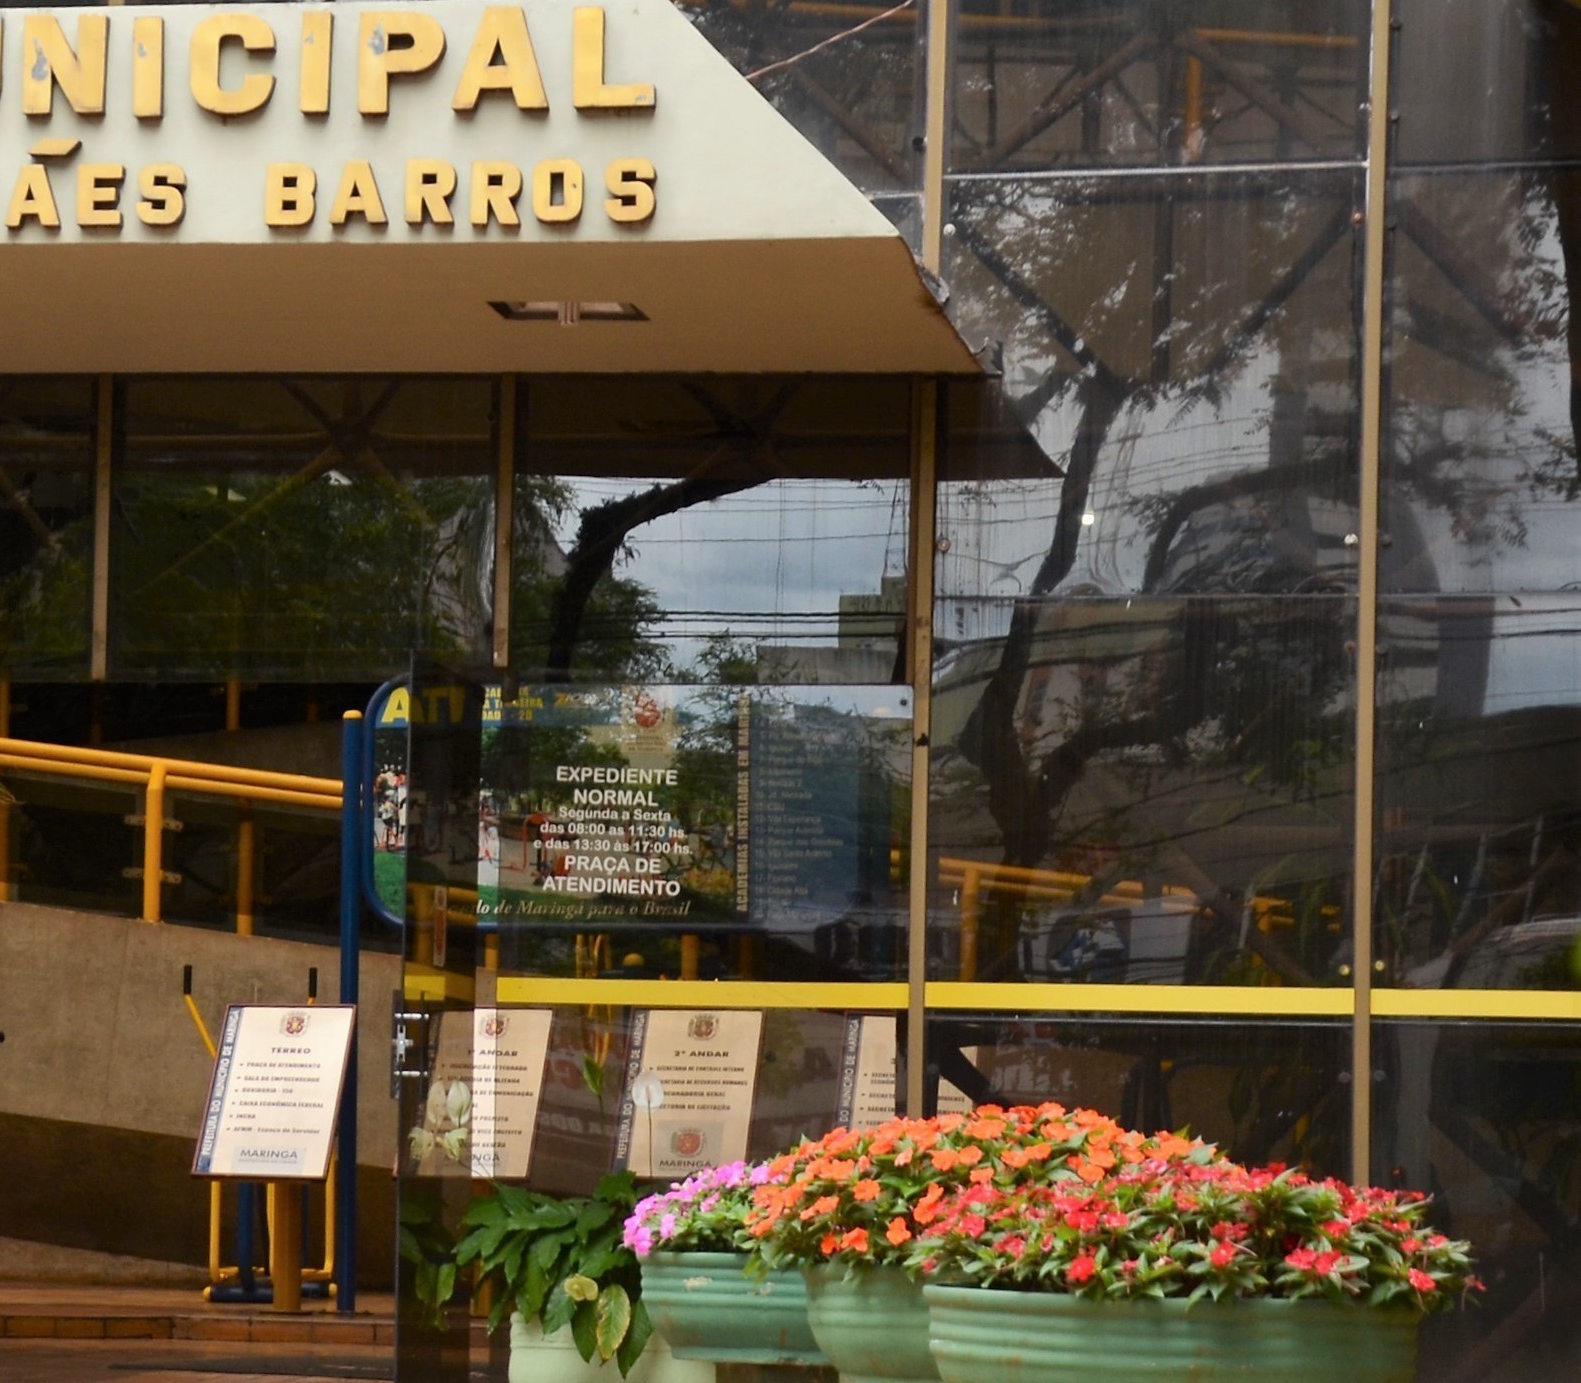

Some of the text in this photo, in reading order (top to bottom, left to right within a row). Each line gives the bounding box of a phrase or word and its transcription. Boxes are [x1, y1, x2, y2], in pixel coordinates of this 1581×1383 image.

[264, 157, 658, 229] BARROS
[556, 765, 679, 786] EXPEDIENTE
[574, 789, 659, 807] NORMAL
[737, 771, 749, 839] INSTALADAS
[559, 806, 671, 821] Segunda a Sexta
[540, 822, 565, 834] das
[568, 823, 606, 835] 08:00
[628, 825, 666, 838] 11:30
[669, 826, 688, 838] hs.
[533, 840, 542, 849] e
[545, 838, 570, 850] das
[574, 839, 610, 851] 13:30
[633, 842, 670, 854] 17:00
[673, 843, 693, 855] hs.
[564, 855, 661, 876] PRAÇA DE
[542, 876, 680, 896] ATENDIMENTO
[736, 844, 748, 912] ACADEMIAS
